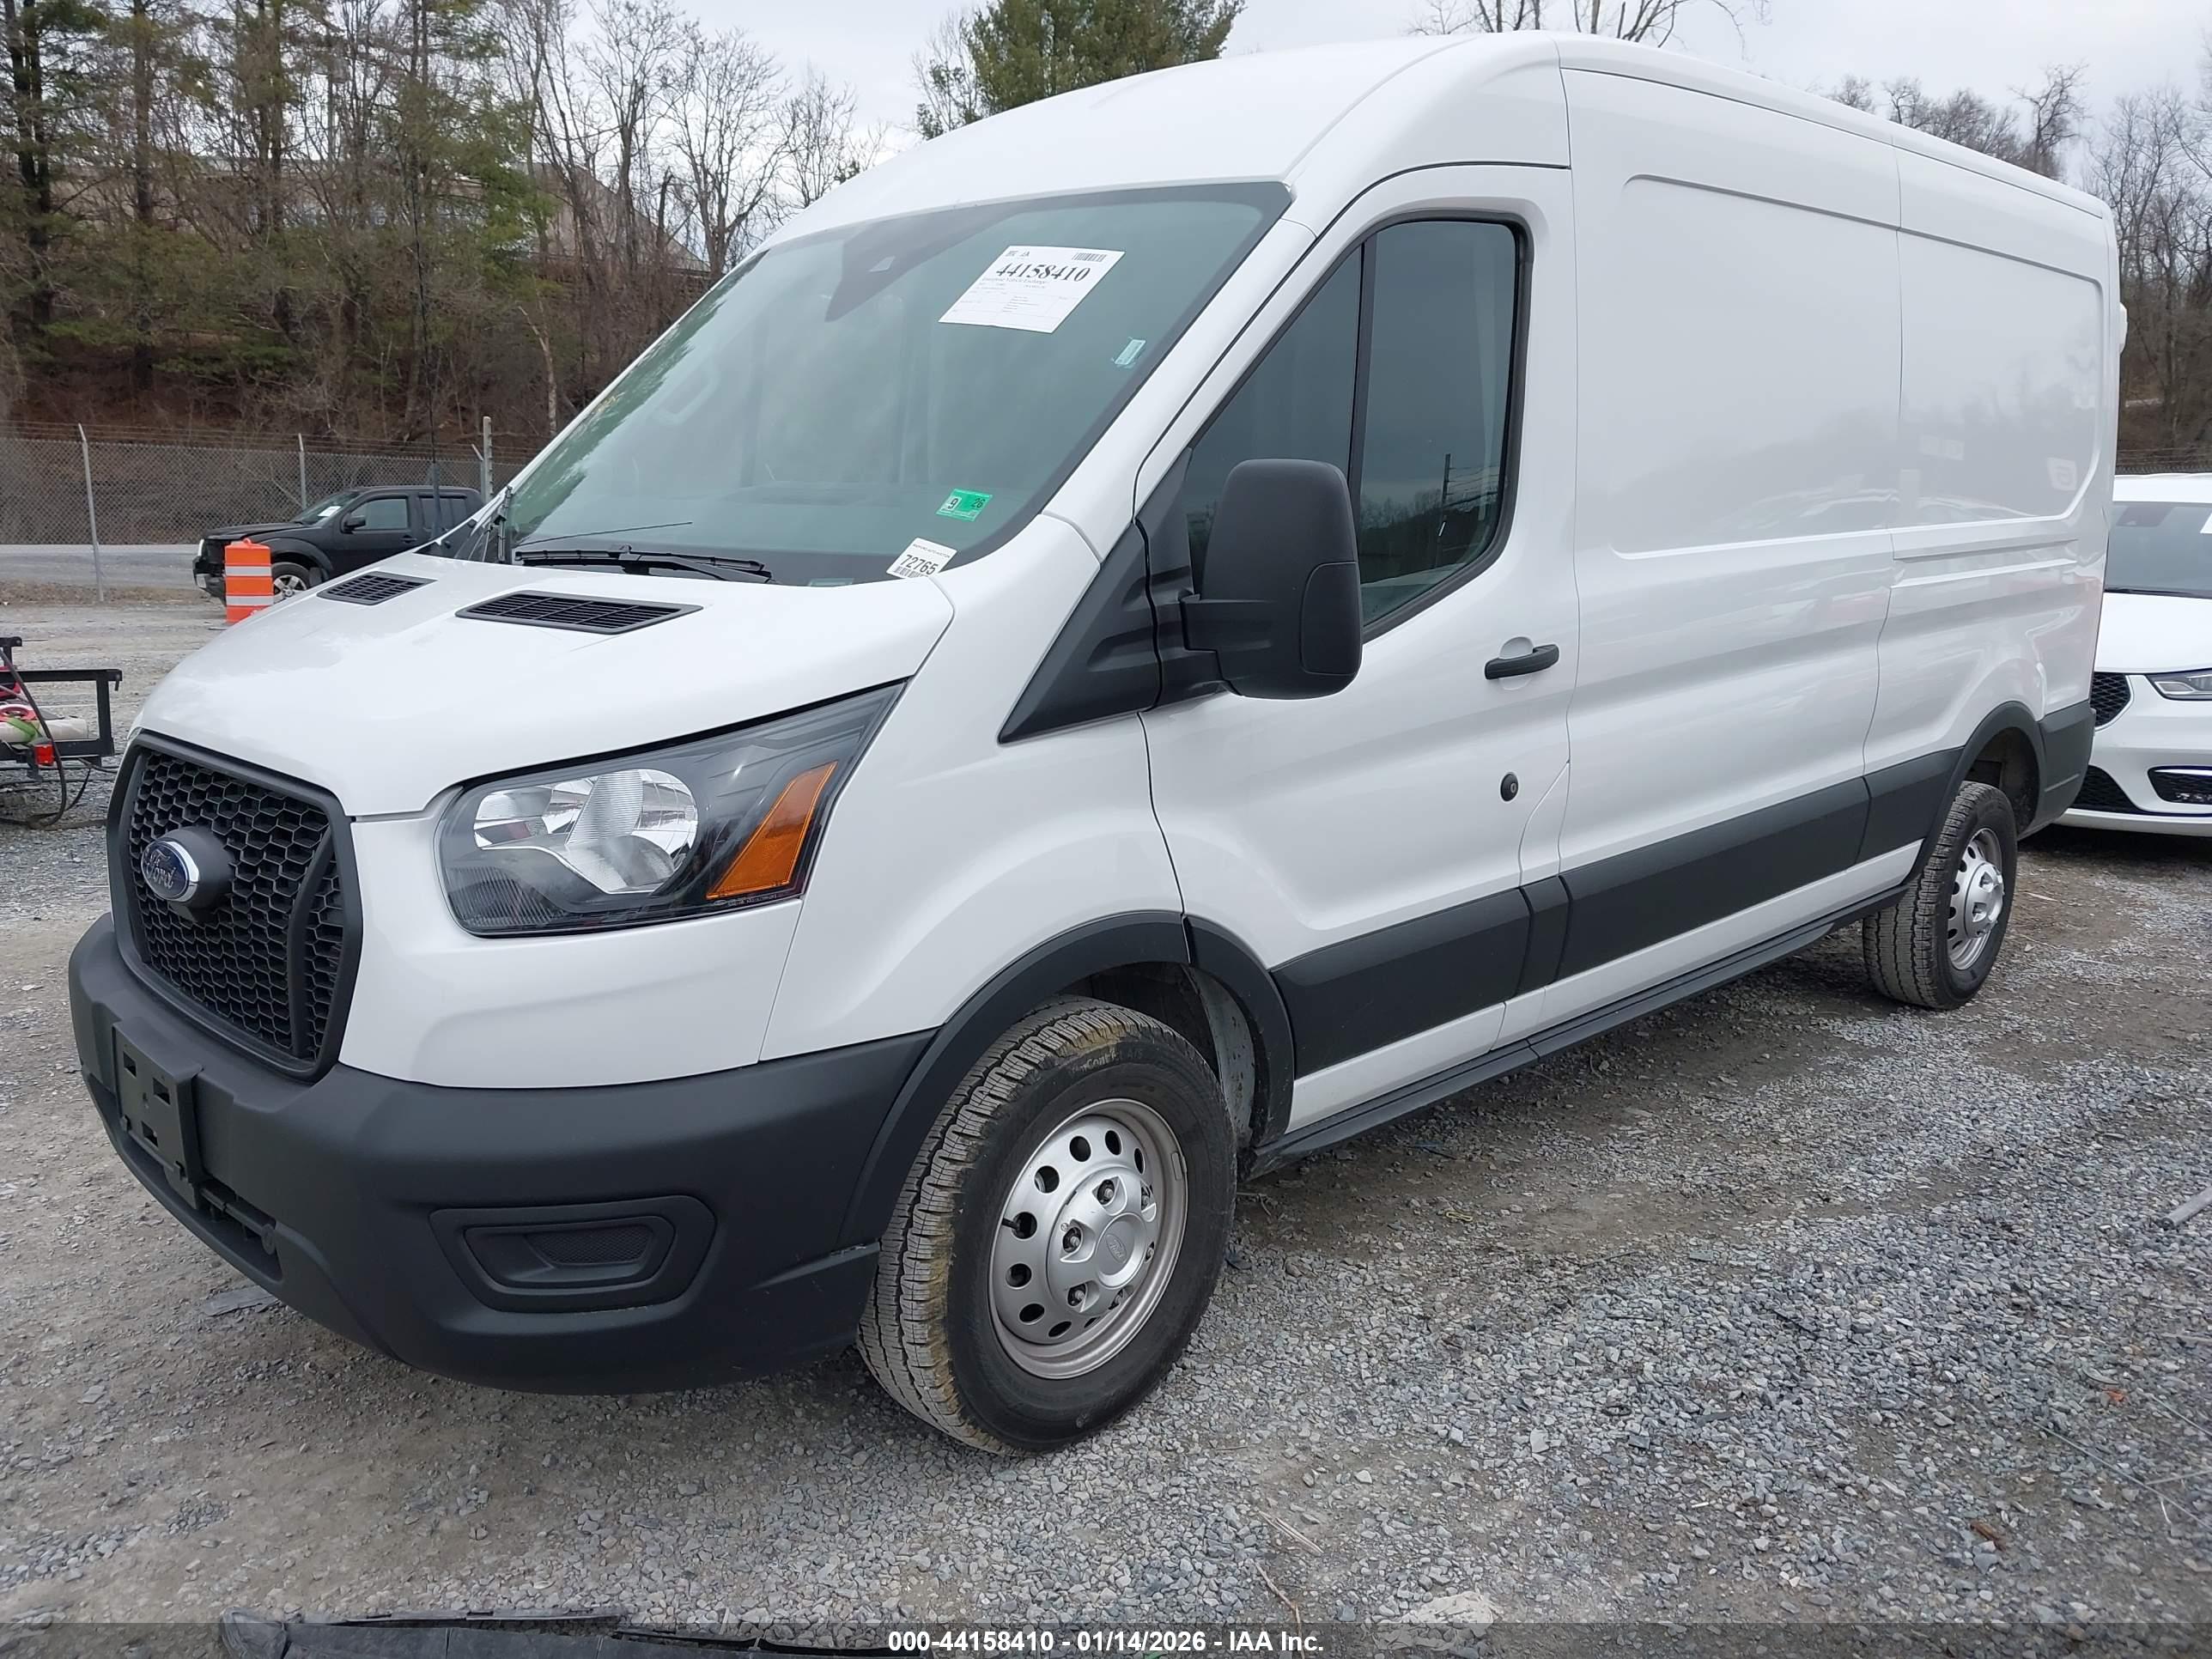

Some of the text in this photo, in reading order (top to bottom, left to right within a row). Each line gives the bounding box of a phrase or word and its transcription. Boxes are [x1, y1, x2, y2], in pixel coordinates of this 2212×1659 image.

[996, 262, 1091, 283] 44158410
[947, 497, 959, 509] 9
[900, 554, 939, 575] 72765
[145, 848, 178, 890] Ford
